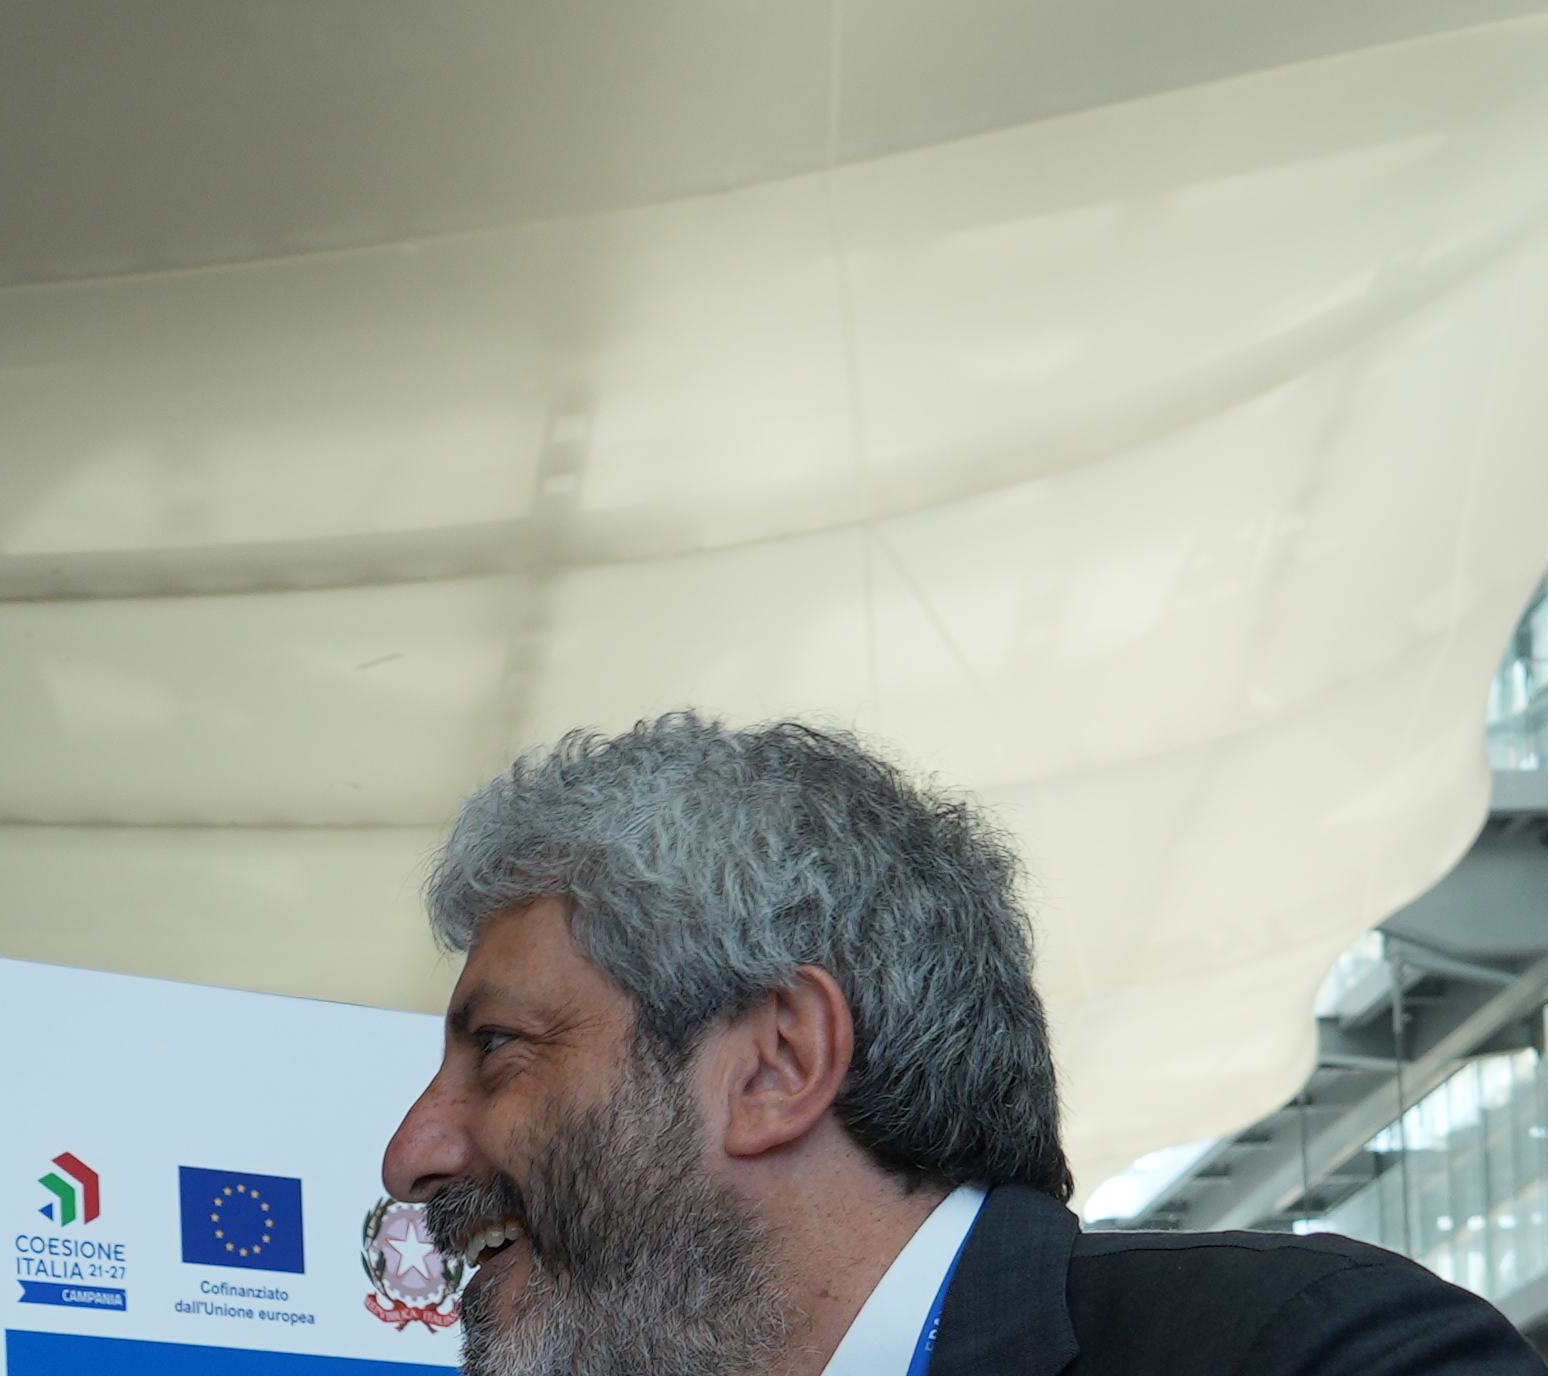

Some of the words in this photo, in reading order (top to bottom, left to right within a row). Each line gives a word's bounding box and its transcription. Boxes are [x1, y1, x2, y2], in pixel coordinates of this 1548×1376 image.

[15, 1235, 125, 1262] COESIONE
[17, 1257, 84, 1280] ITALIA
[88, 1264, 126, 1280] 21-27
[61, 1289, 123, 1307] CAMPANIA
[200, 1280, 289, 1301] Cofinanziato
[175, 1300, 254, 1320] dall'Unione
[258, 1309, 315, 1326] europea
